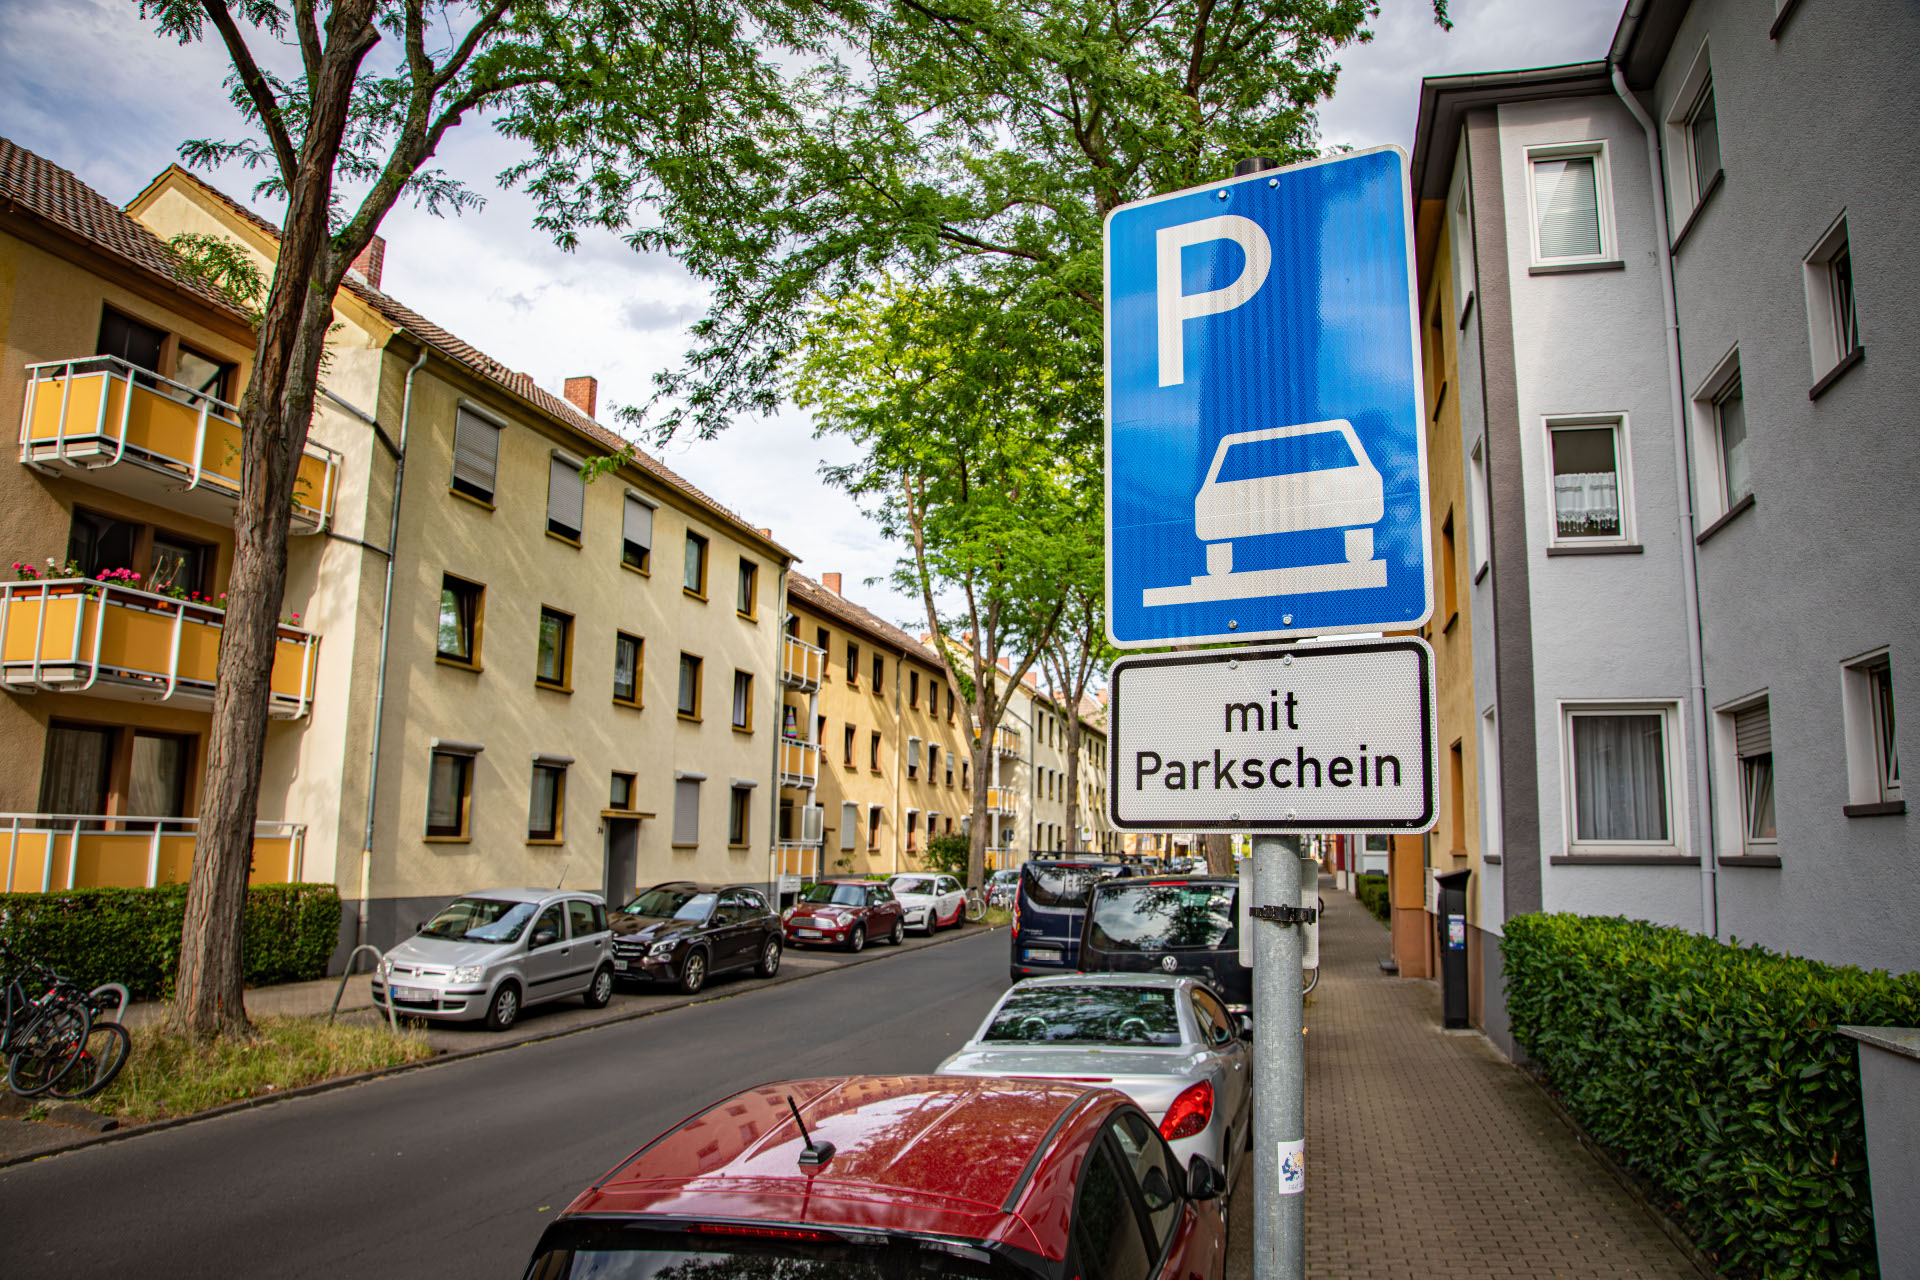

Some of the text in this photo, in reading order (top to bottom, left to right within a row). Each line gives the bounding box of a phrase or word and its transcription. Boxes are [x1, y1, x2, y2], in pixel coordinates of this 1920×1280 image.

[1156, 214, 1272, 388] P
[1225, 689, 1299, 733] mit
[1136, 744, 1401, 791] Parkschein
